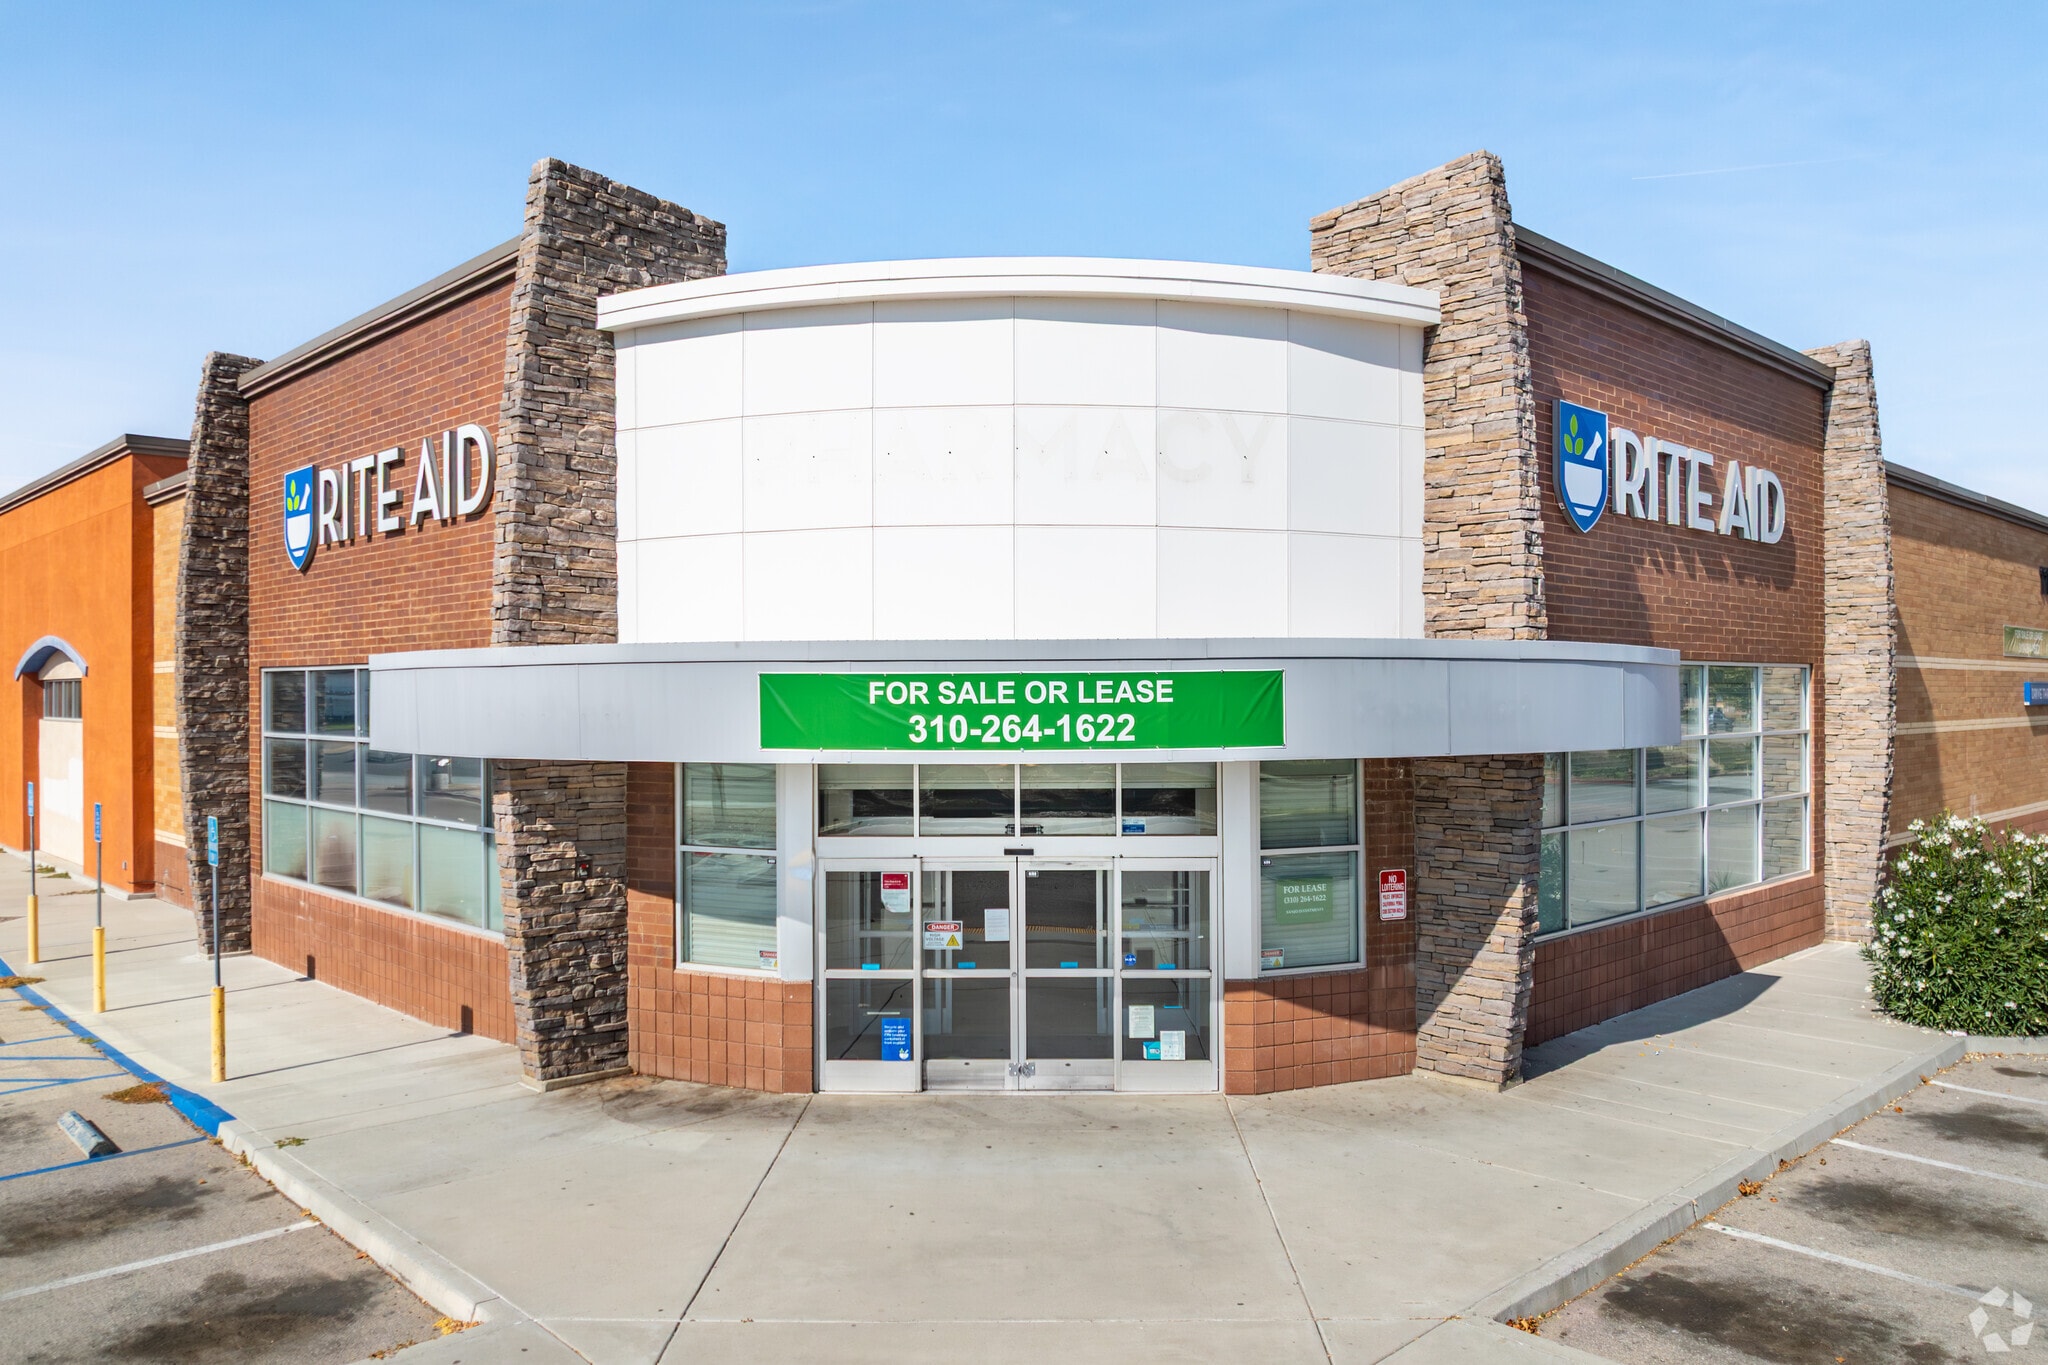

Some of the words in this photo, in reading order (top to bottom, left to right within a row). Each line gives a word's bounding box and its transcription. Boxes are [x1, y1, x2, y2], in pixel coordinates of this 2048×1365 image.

[319, 447, 405, 545] RITE
[410, 423, 496, 526] AID
[1611, 427, 1715, 532] RITE
[1718, 460, 1786, 544] AID
[868, 681, 930, 705] FOR
[938, 681, 1016, 704] SALE
[1024, 681, 1069, 704] OR
[1078, 680, 1174, 703] LEASE
[908, 714, 1136, 743] 310-264-1622
[1283, 885, 1300, 894] FOR
[1301, 883, 1327, 893] LEASE
[1382, 883, 1404, 892] LOITERING
[1388, 875, 1397, 883] NO
